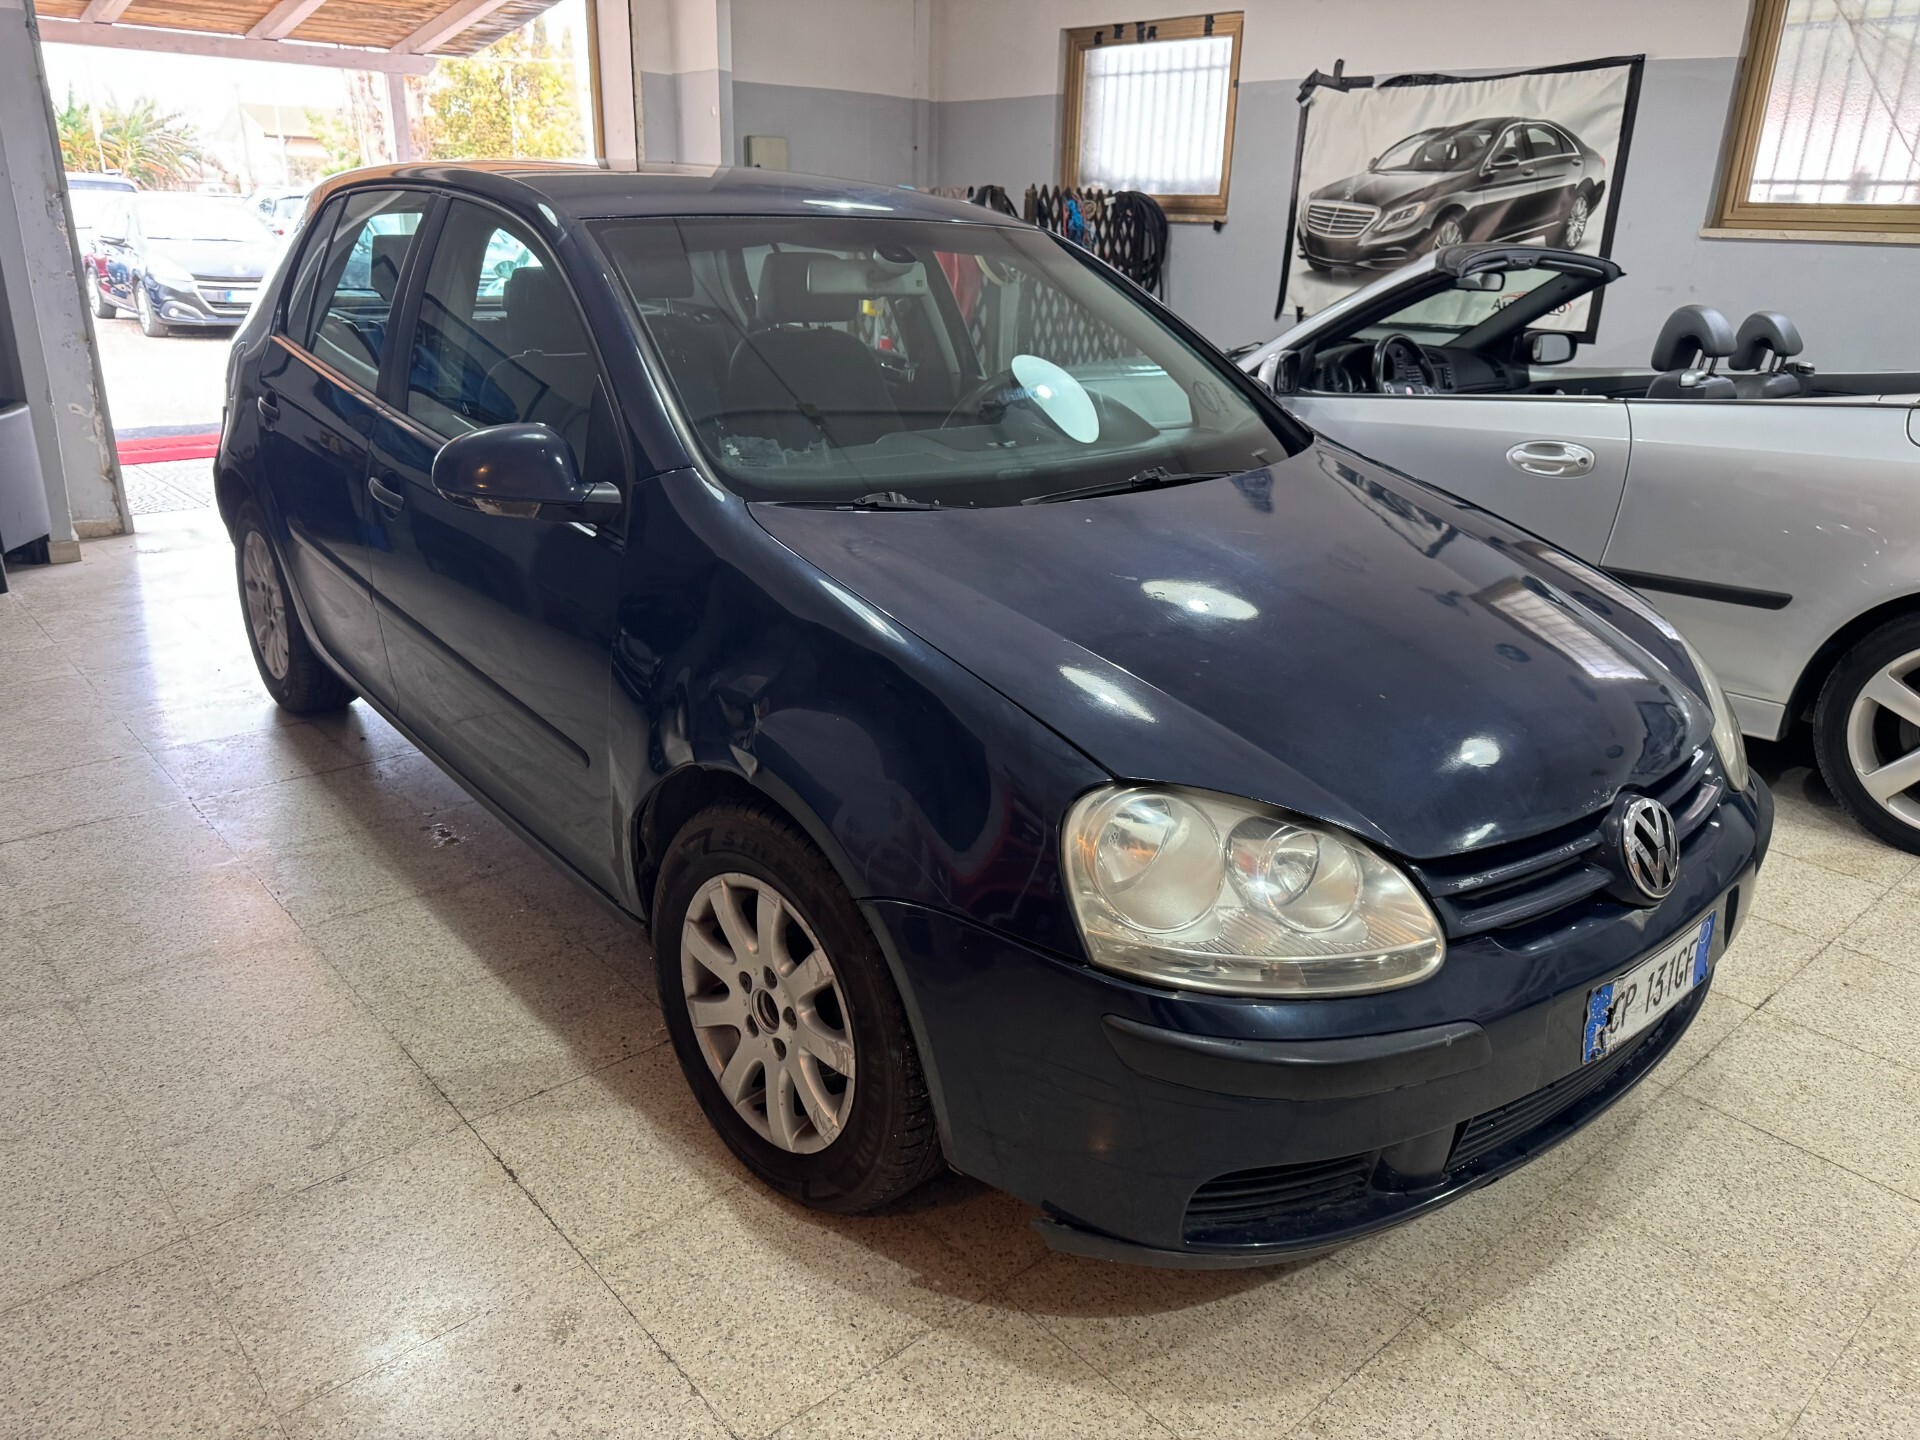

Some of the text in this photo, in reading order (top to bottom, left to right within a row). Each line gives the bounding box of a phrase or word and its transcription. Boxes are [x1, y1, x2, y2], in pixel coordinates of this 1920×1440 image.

[1624, 799, 1679, 897] VW
[1609, 938, 1698, 1033] CP 131GF
